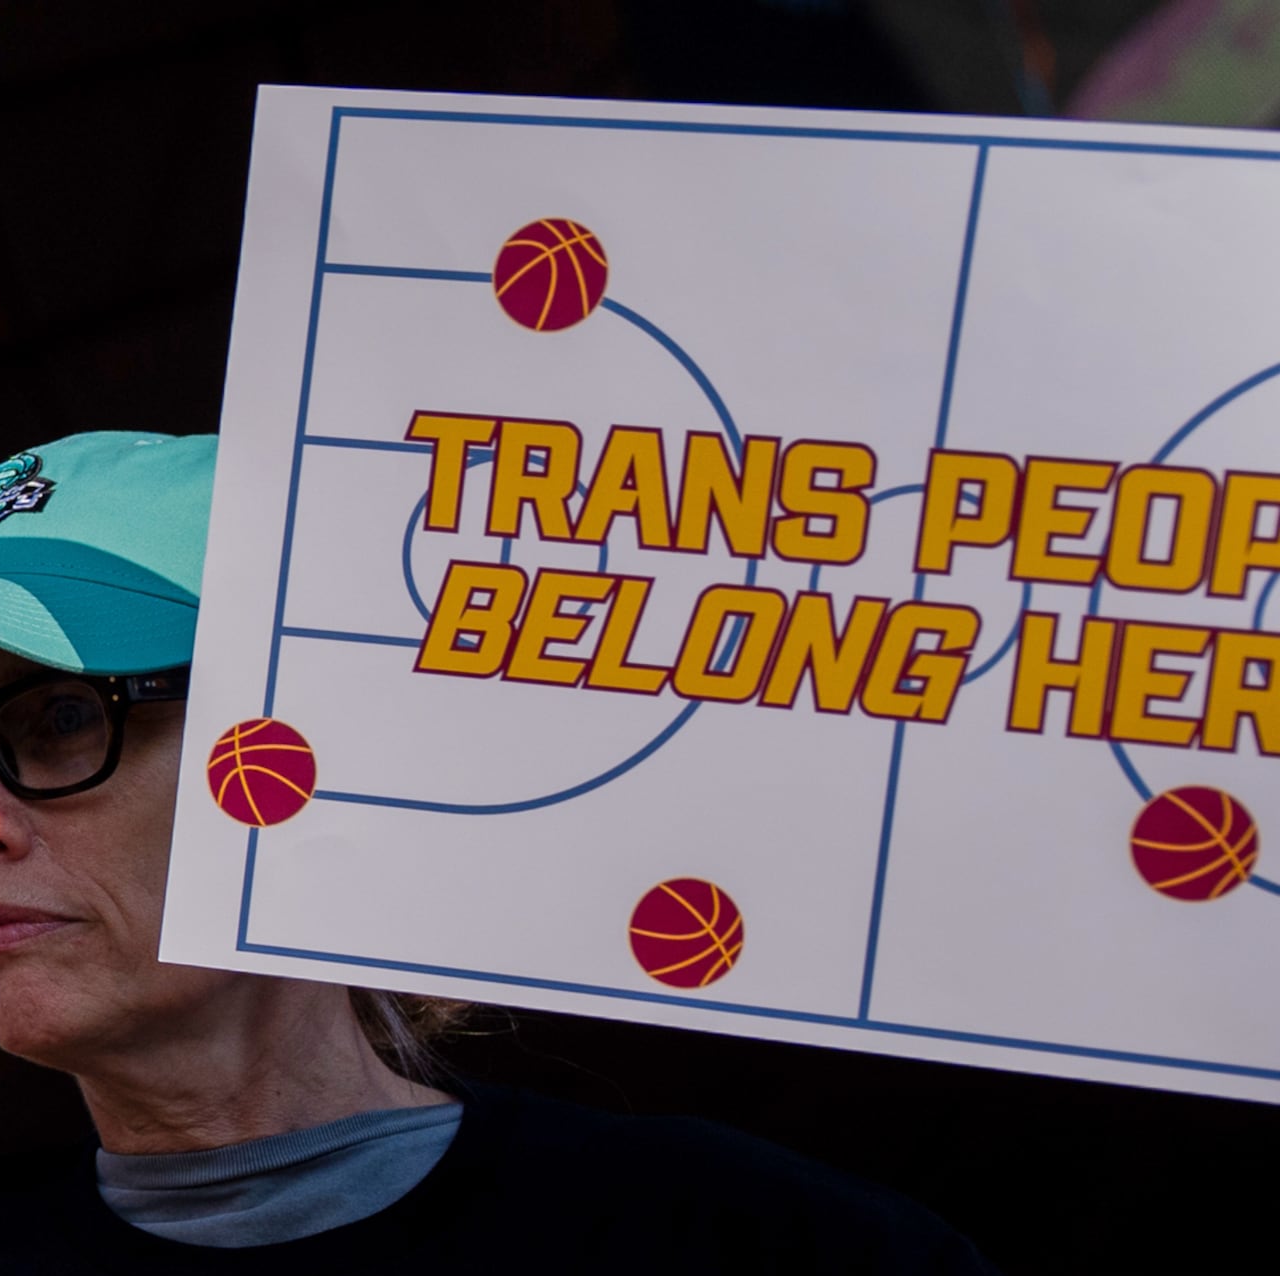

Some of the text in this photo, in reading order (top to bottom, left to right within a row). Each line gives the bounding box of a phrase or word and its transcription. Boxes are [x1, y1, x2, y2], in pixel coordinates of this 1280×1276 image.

[408, 411, 877, 565] TRANS
[414, 560, 1280, 757] BELONG HER
